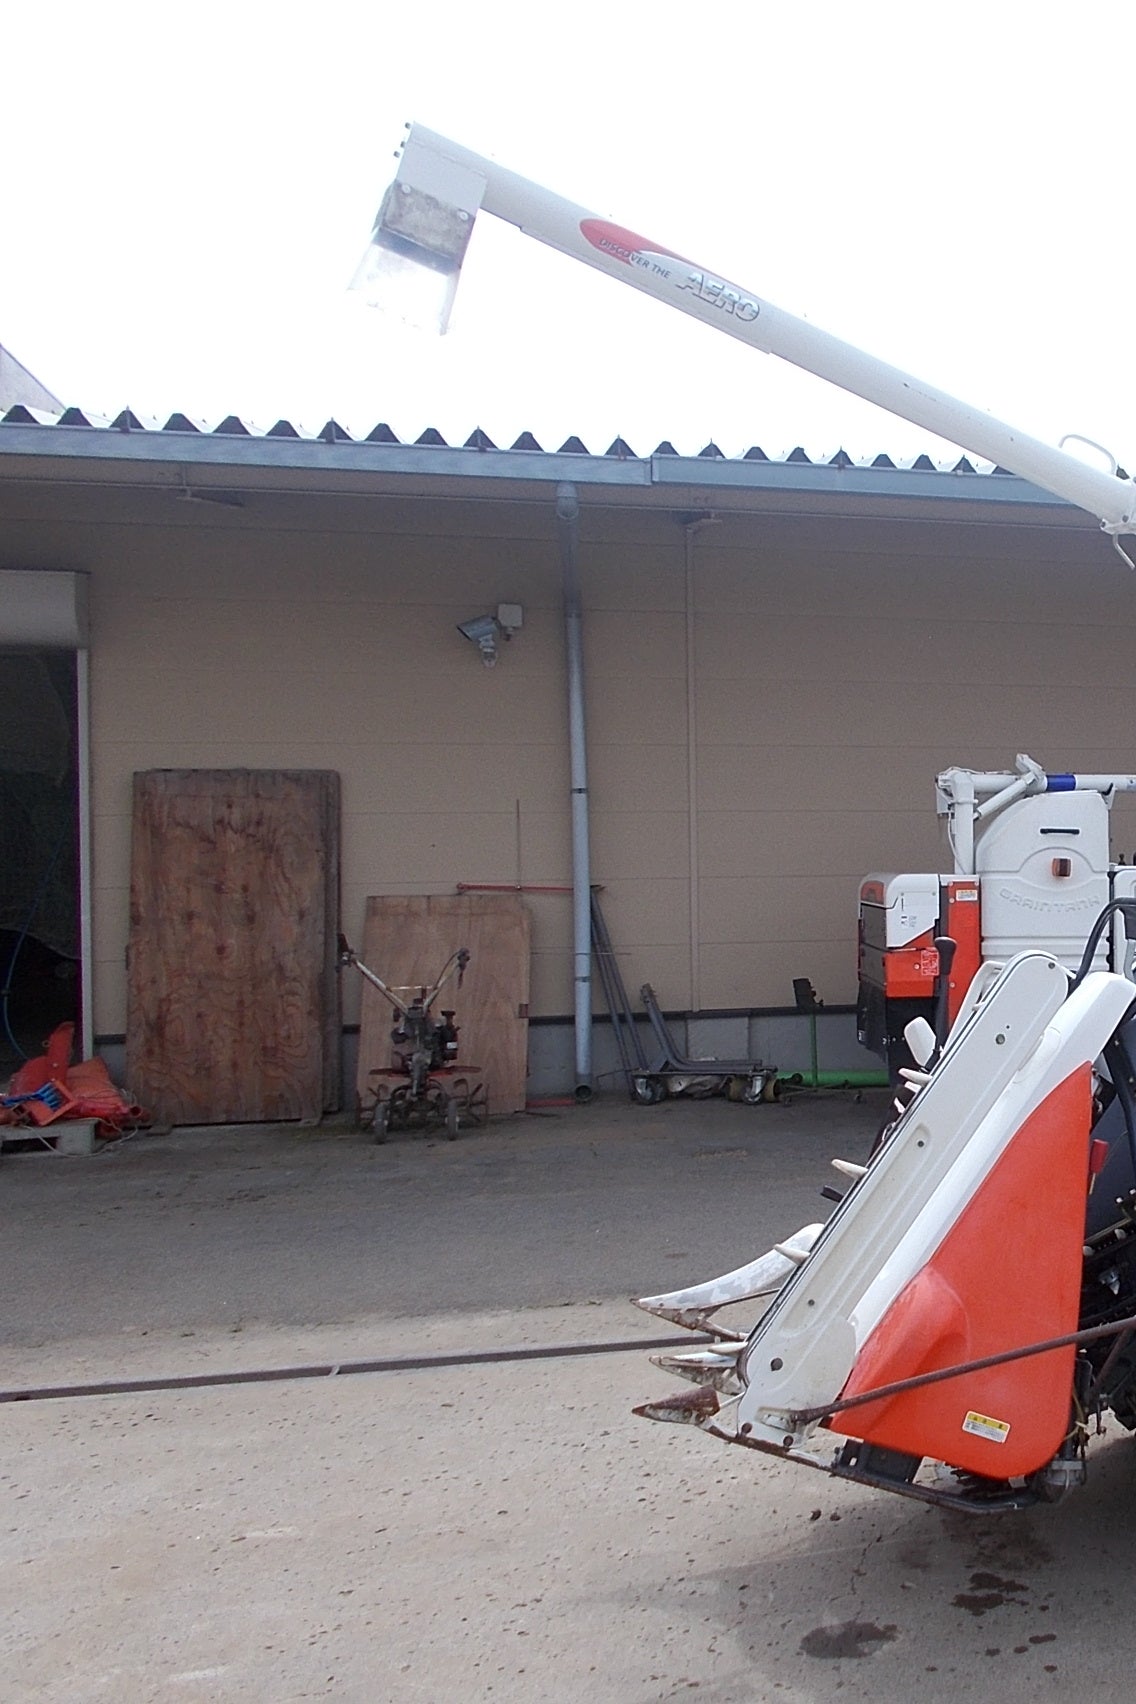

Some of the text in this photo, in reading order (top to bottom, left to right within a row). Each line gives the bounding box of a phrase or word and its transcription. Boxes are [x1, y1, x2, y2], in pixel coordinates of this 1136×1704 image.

[600, 239, 760, 321] DISCOVER THE AERO
